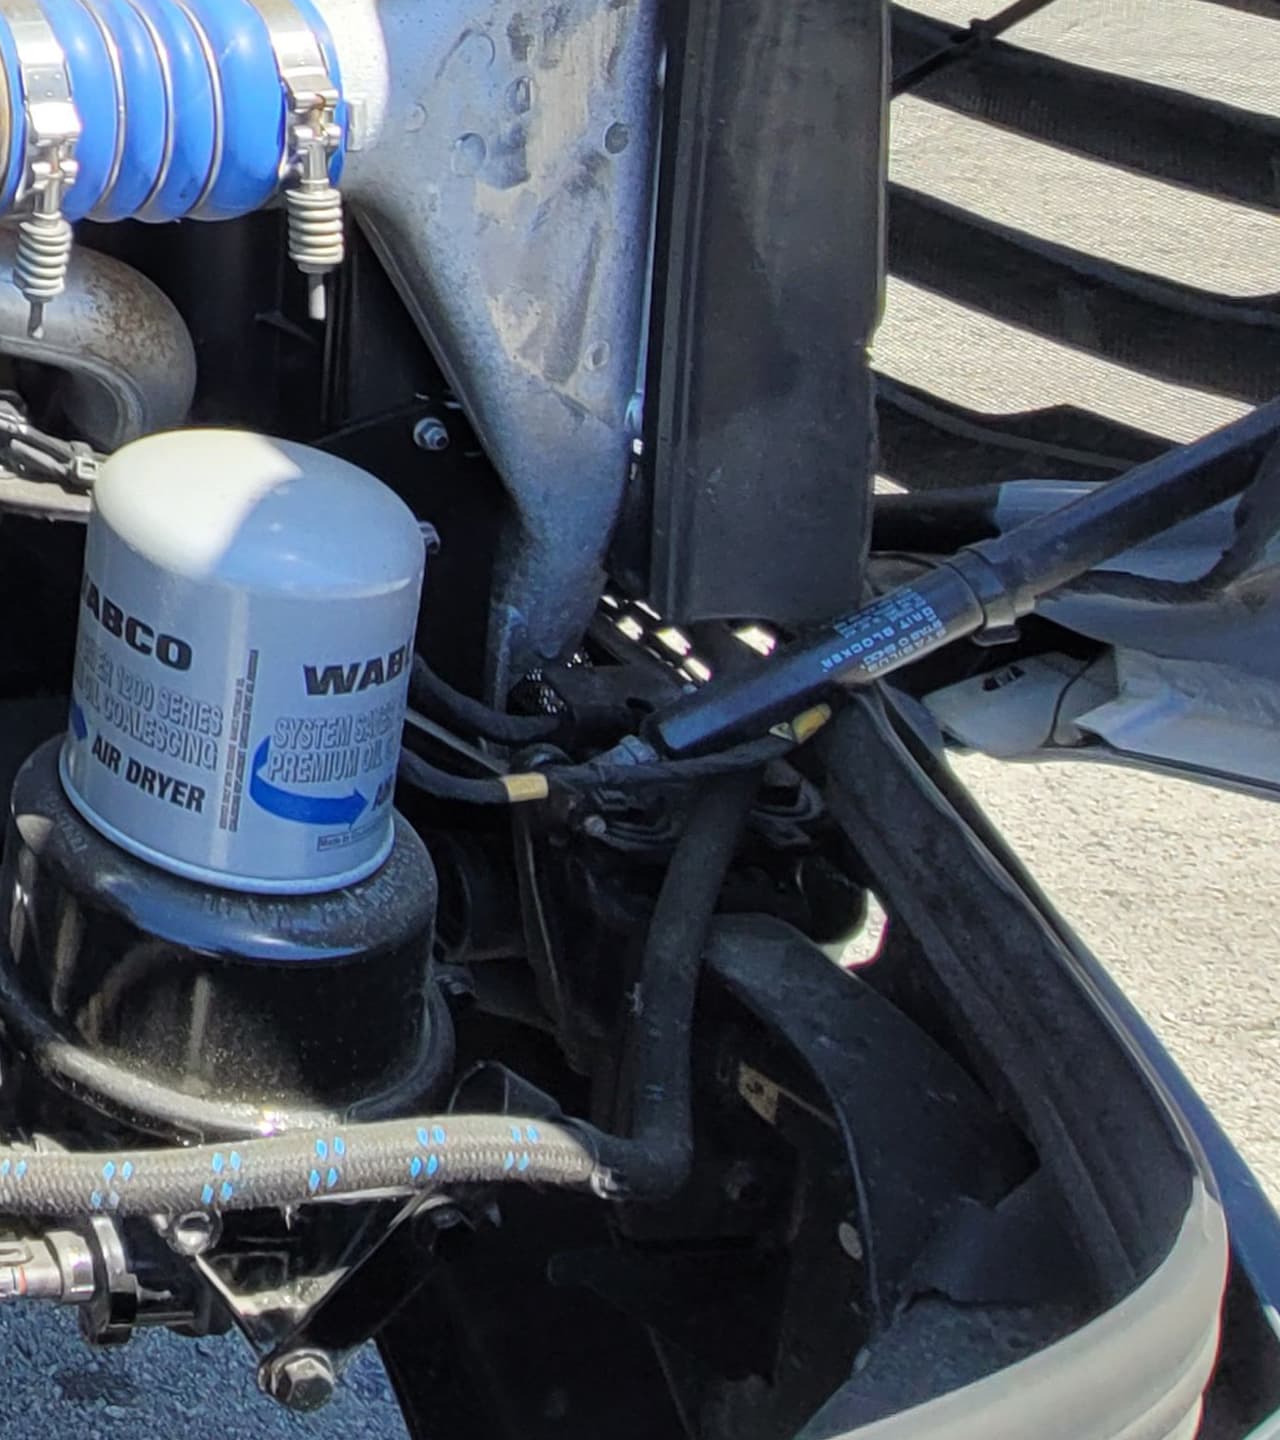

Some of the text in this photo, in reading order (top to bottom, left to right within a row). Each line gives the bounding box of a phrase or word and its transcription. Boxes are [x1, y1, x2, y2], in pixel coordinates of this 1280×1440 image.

[83, 572, 193, 672] ABCO
[821, 625, 896, 669] BLOCKER
[302, 638, 412, 697] WAB
[159, 687, 224, 738] SERIES
[273, 713, 354, 750] SYSTEM
[92, 733, 206, 814] AIR DRYER
[267, 745, 360, 784] PREMIUM
